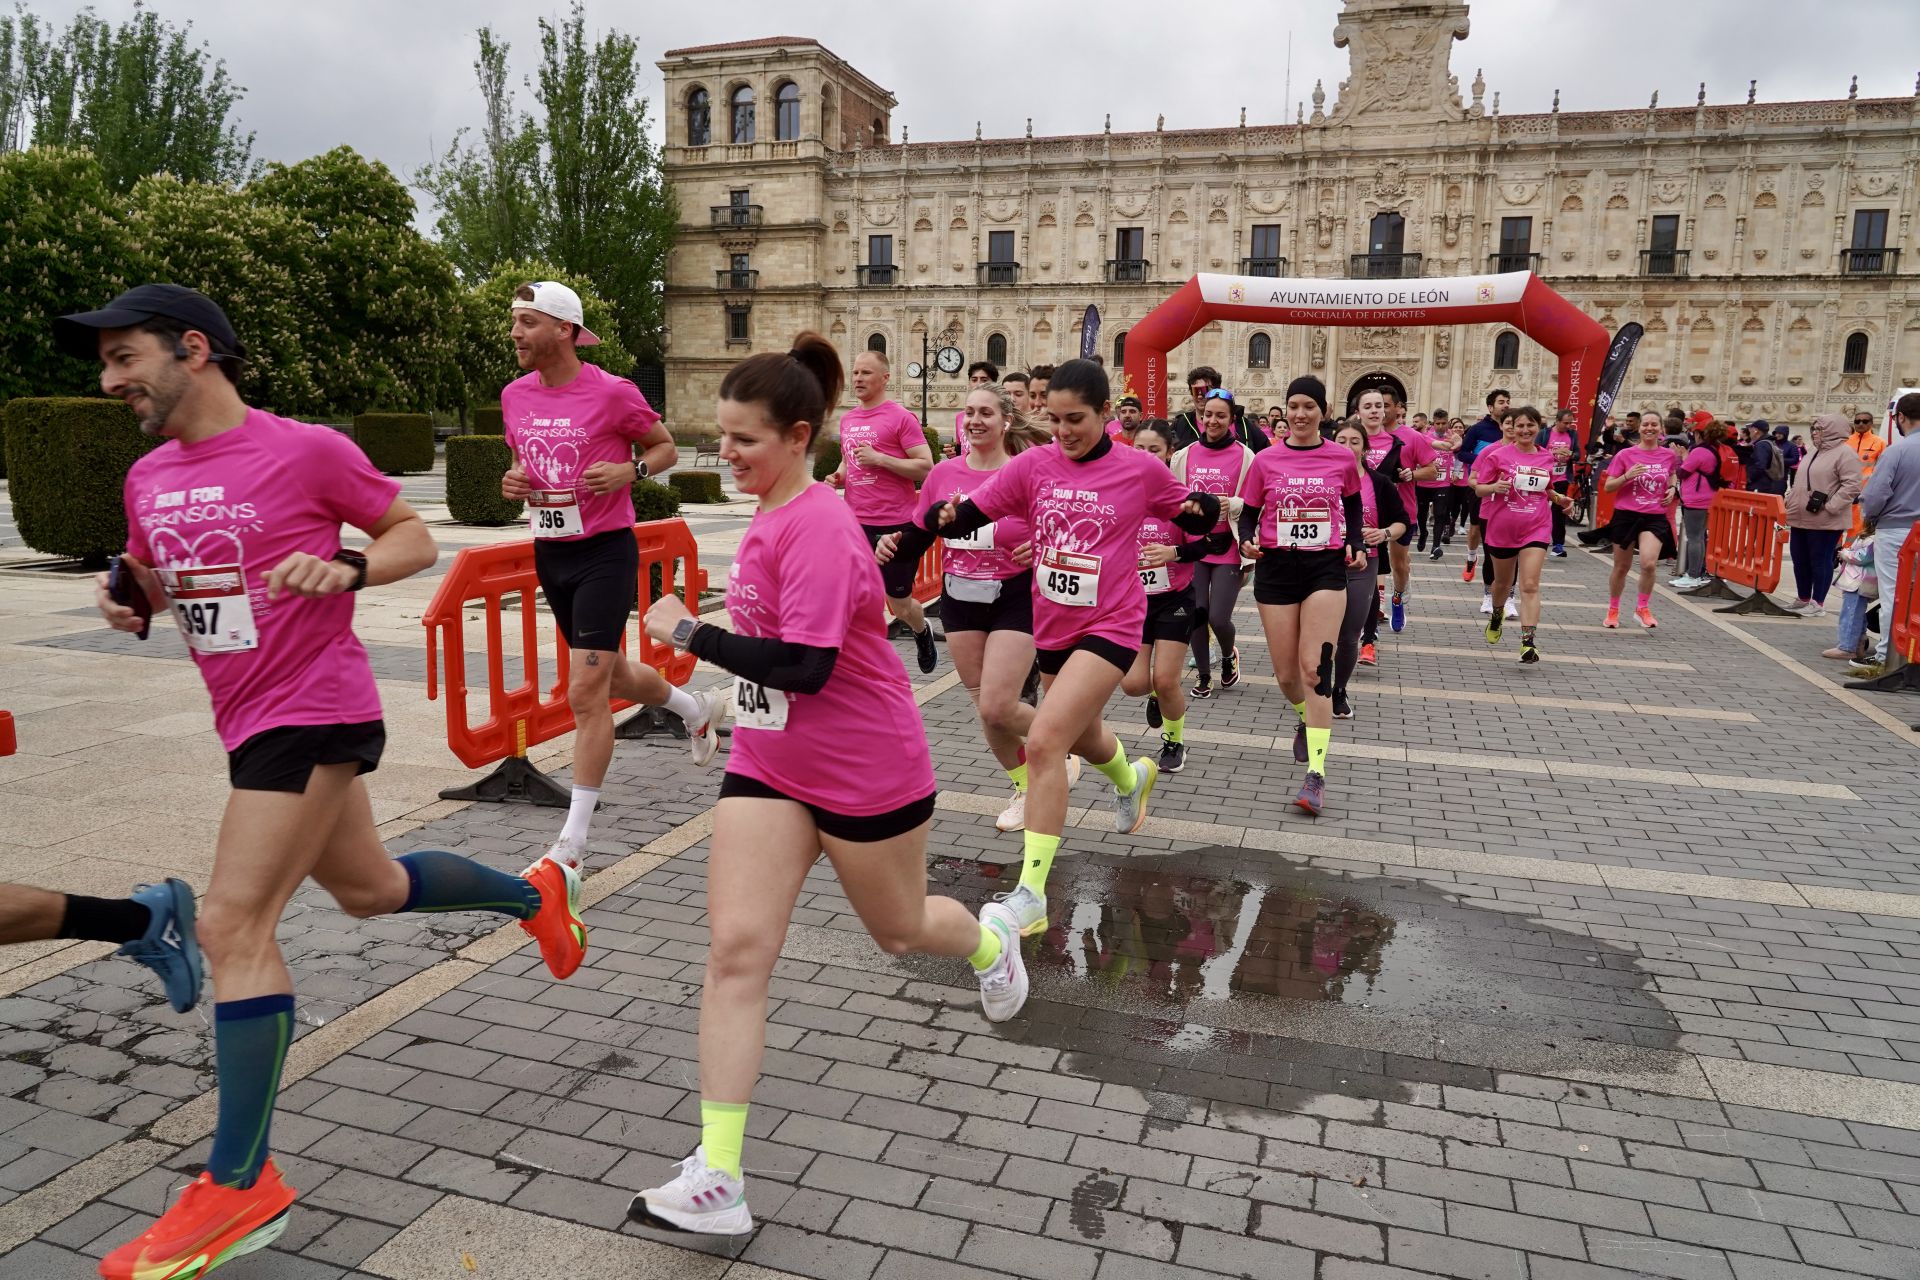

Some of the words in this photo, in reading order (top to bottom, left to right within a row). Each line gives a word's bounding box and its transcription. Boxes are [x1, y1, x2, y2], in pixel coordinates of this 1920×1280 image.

[1270, 290, 1384, 305] AYUNTAMIENTO
[1388, 292, 1406, 304] DE
[1411, 288, 1449, 303] LEÓN
[1290, 308, 1352, 320] CONCEJALÍA
[1356, 310, 1369, 319] DE
[1373, 309, 1426, 319] DEPORTES
[1147, 357, 1156, 406] DEPORTES
[1569, 360, 1581, 413] DEPORTES
[533, 418, 551, 427] RUN
[553, 418, 571, 427] FOR
[1288, 478, 1305, 486] RUN
[1307, 478, 1324, 486] FOR
[1528, 477, 1539, 487] 51
[190, 486, 224, 504] FOR
[1053, 488, 1073, 500] RUN
[1076, 490, 1098, 502] FOR
[539, 510, 565, 529] 396
[1282, 509, 1298, 518] RUN
[1143, 524, 1158, 532] FOR
[1290, 524, 1318, 539] 433
[1047, 571, 1080, 596] 435
[1139, 570, 1157, 585] 32
[737, 681, 771, 714] 434
